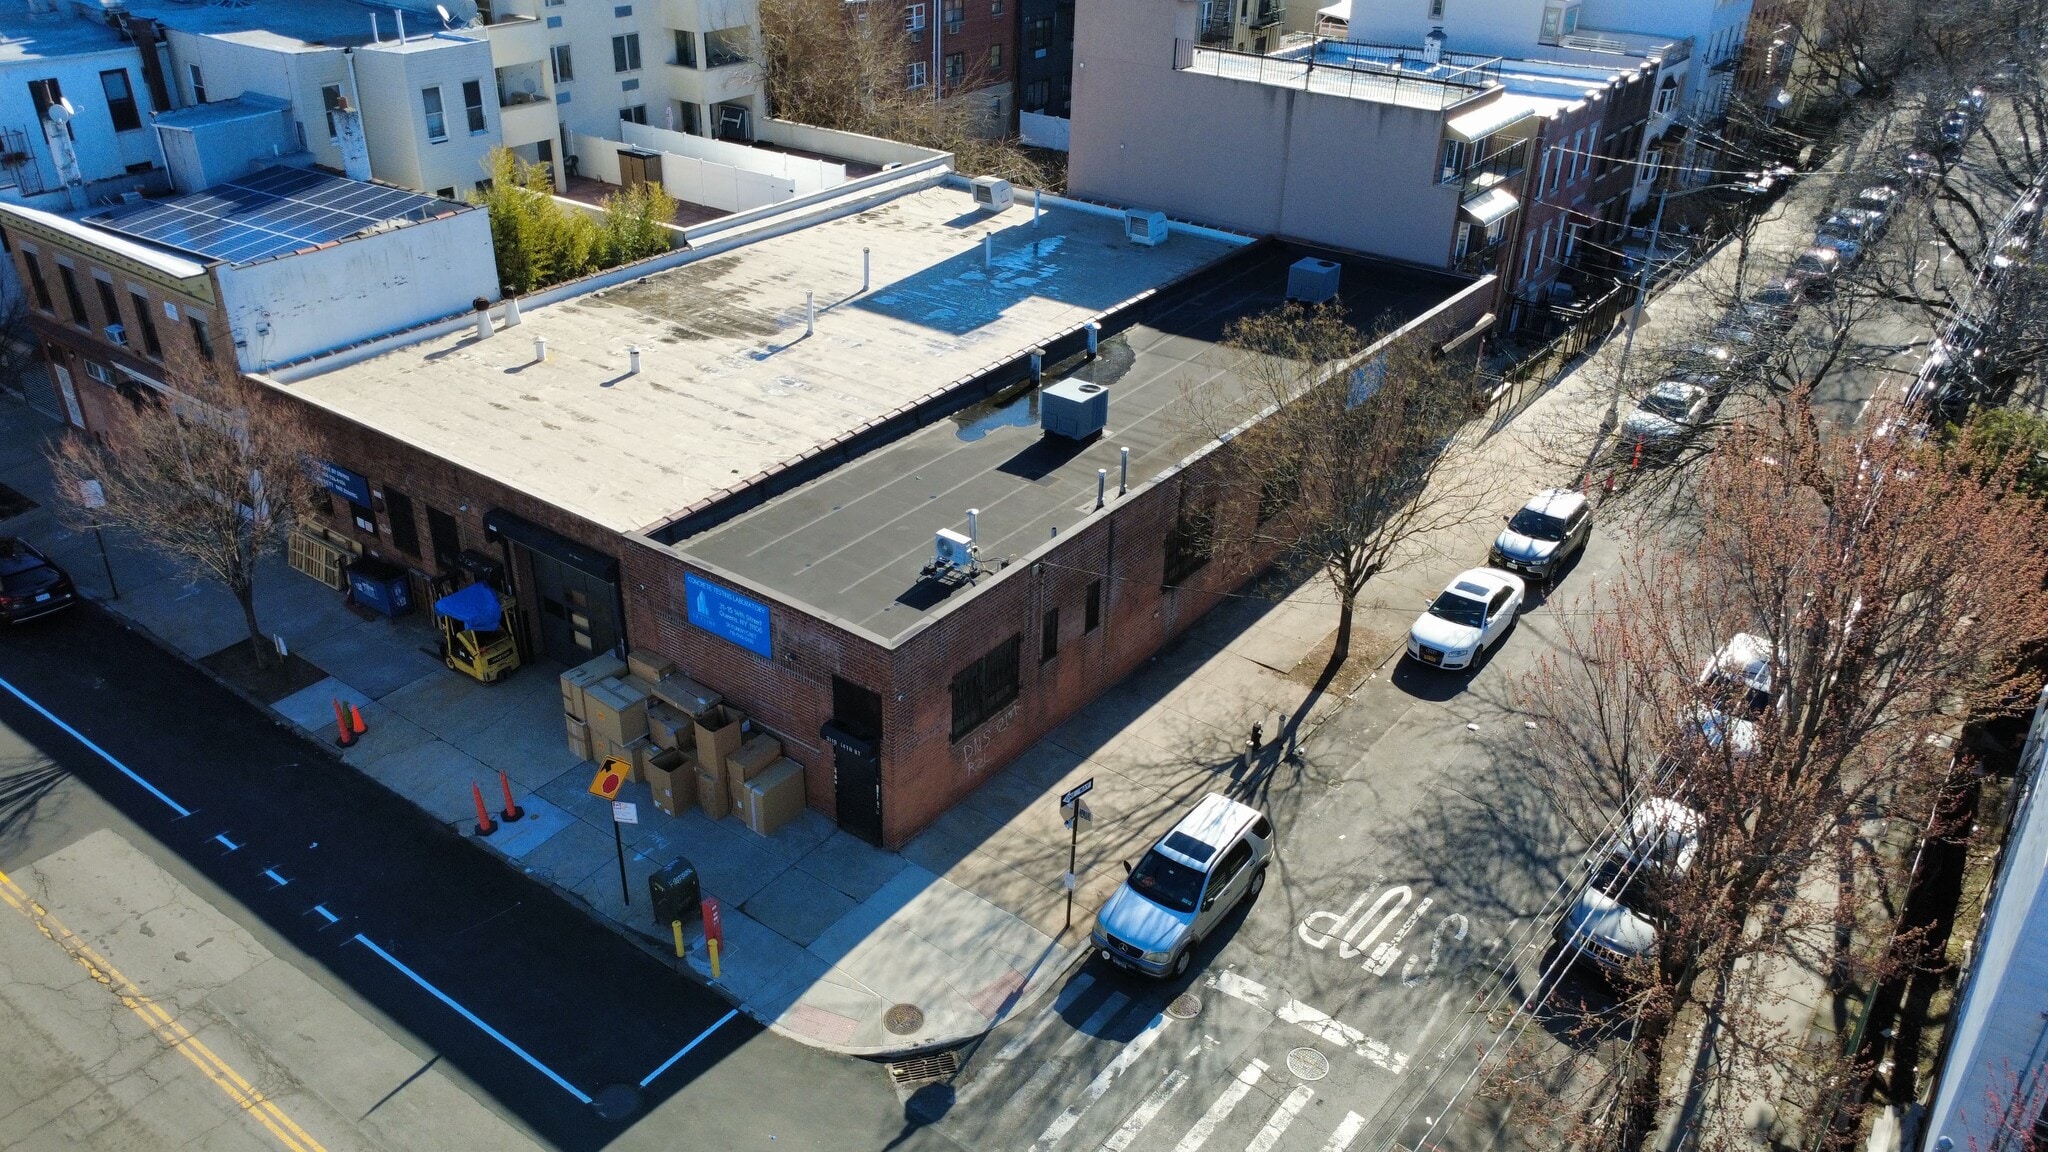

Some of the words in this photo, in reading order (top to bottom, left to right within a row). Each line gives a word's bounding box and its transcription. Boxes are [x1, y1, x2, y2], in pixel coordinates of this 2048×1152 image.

[687, 576, 713, 592] CONCRETE
[713, 587, 733, 600] TESTING
[733, 595, 766, 614] LABORATORY
[745, 614, 762, 626] Street
[1298, 874, 1468, 988] STOP
